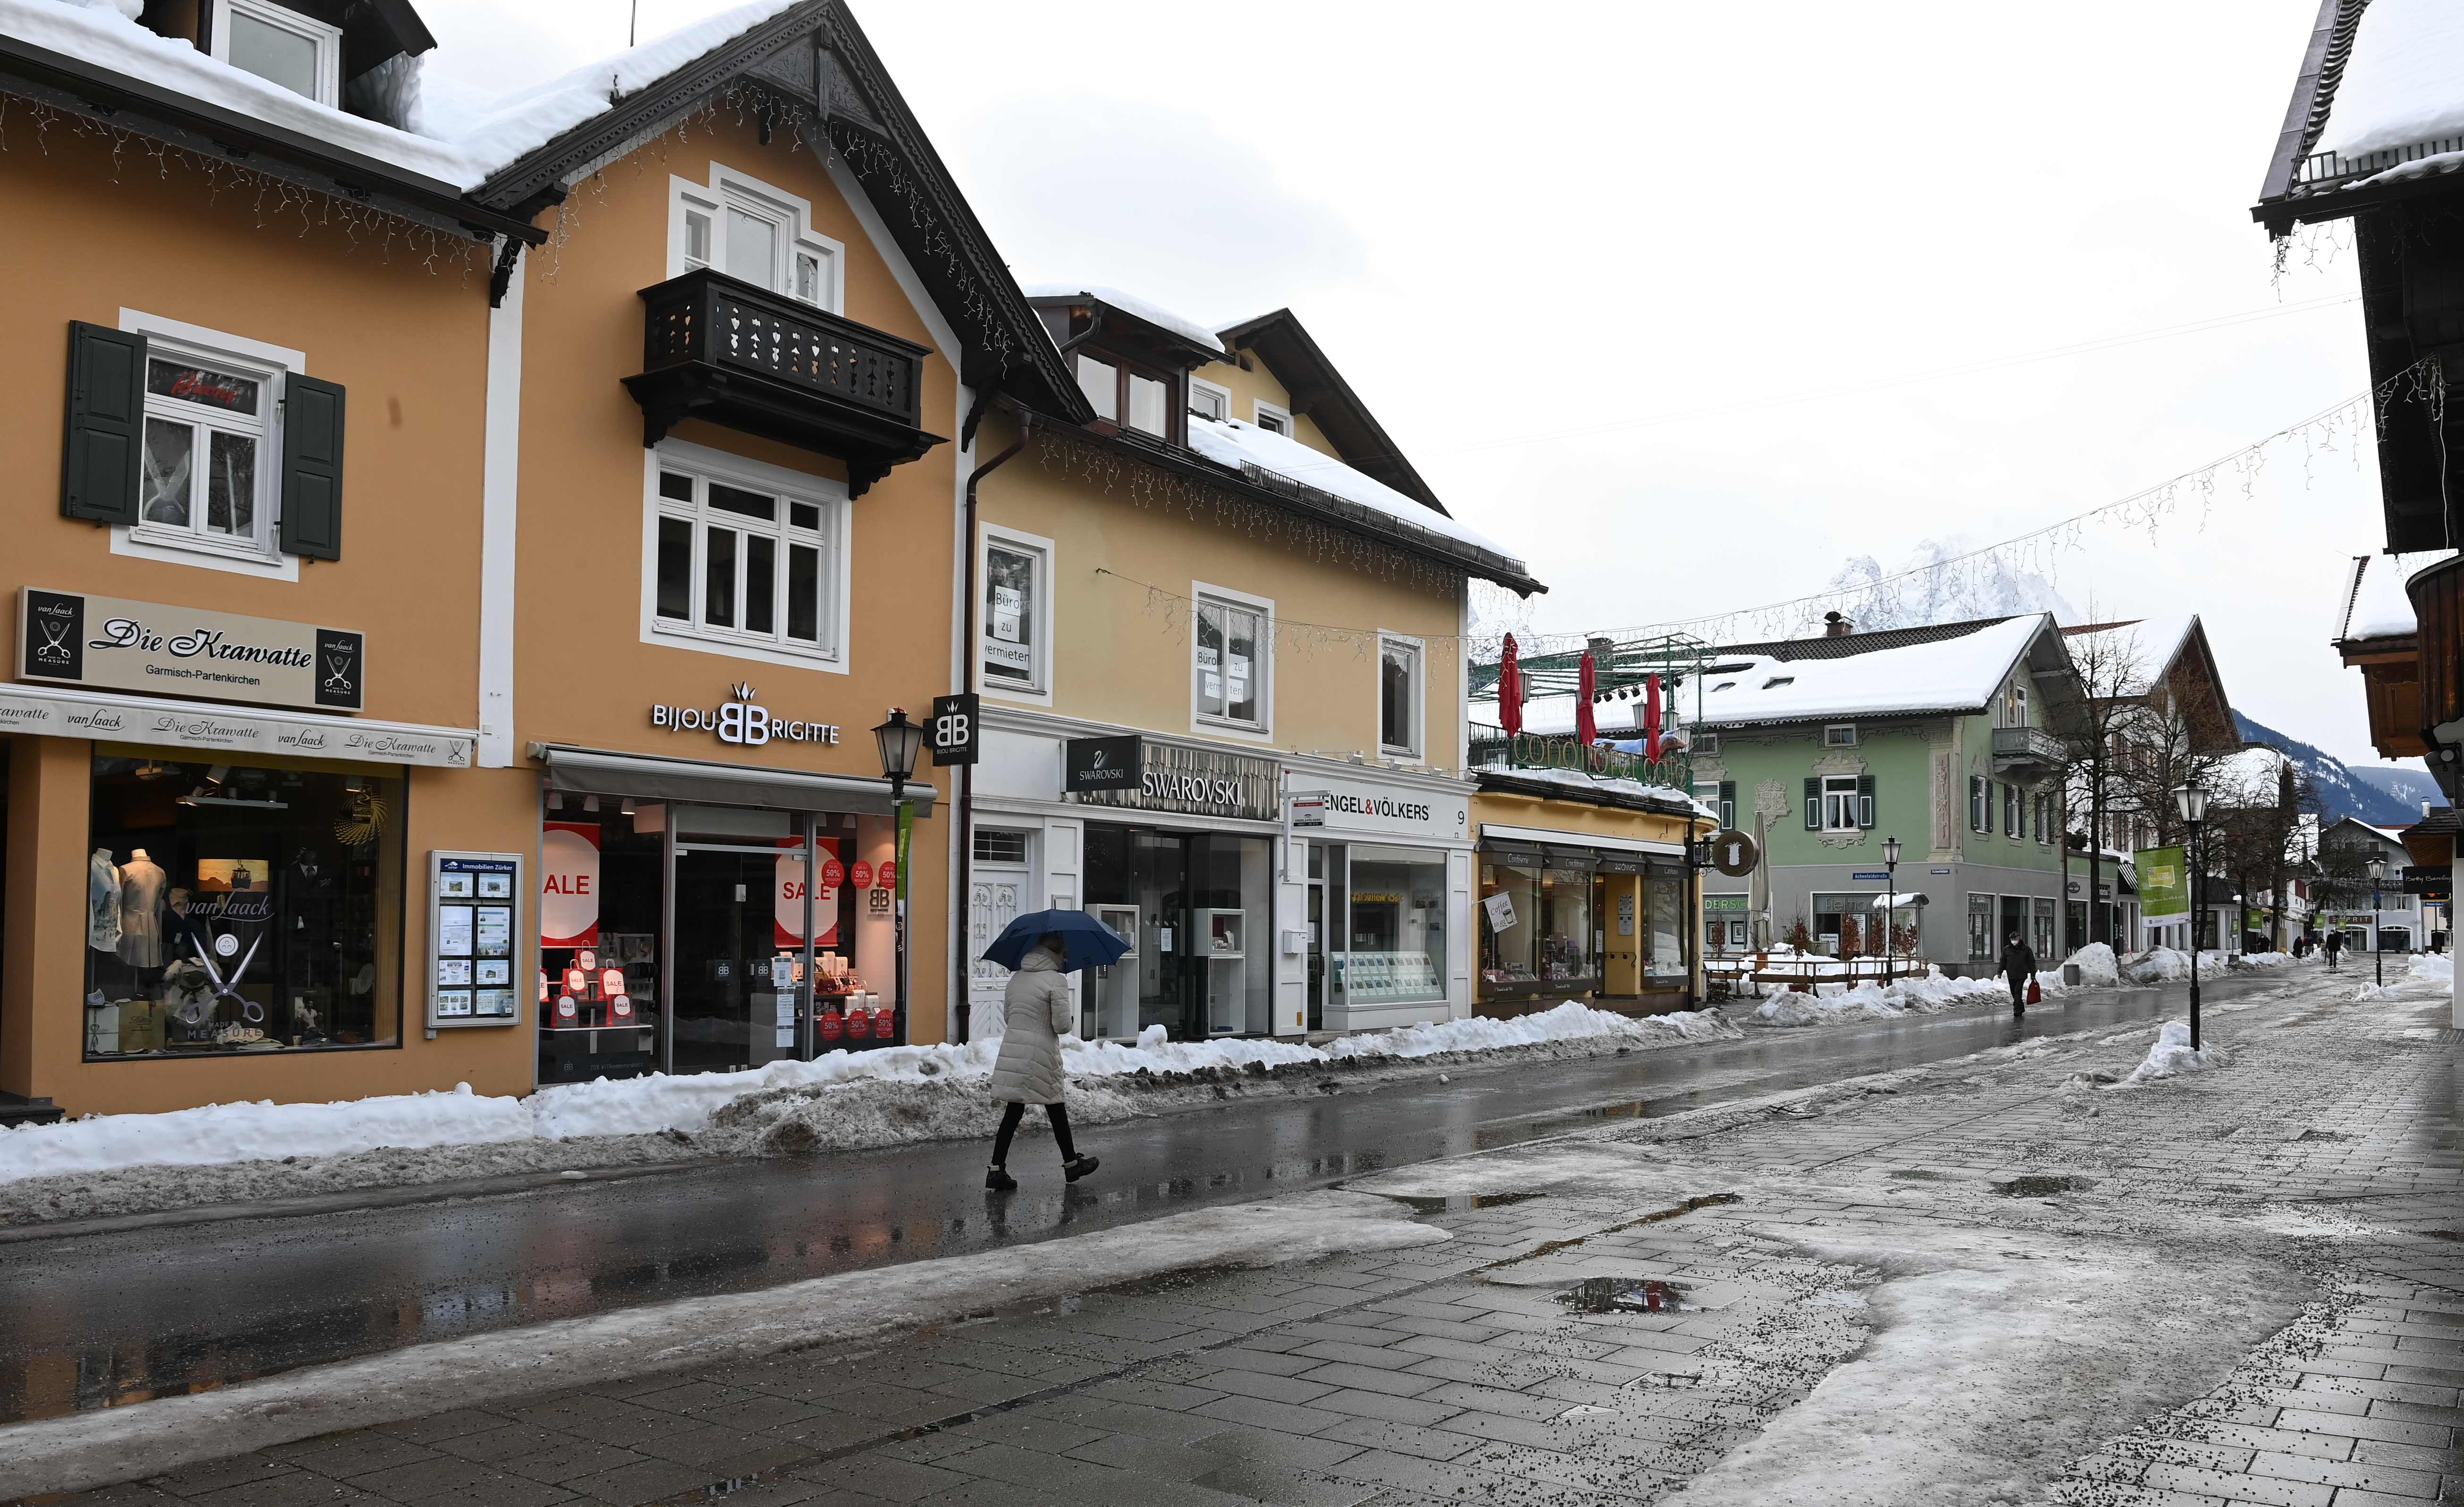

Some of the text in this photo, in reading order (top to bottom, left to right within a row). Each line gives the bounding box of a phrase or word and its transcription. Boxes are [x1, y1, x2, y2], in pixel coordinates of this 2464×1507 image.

[996, 593, 1020, 609] Büro
[48, 603, 75, 618] Laack
[1001, 622, 1011, 632] zu
[89, 618, 312, 668] Die Krawatte
[1198, 652, 1216, 665] Büro
[1234, 663, 1242, 672] zu
[146, 665, 260, 686] Garmisch-Partenkirchen
[1206, 681, 1242, 695] vermten
[0, 708, 49, 720] awatte
[68, 709, 125, 731] van Laack
[654, 704, 716, 732] BIJOU
[151, 717, 259, 738] Die Krawatte
[180, 734, 233, 743] Garmisch-Partenkirchen
[278, 729, 328, 749] van Laack
[344, 734, 436, 753] Die Krawatte
[368, 750, 414, 758] Garmisch-Partenkirchen
[1079, 769, 1123, 781] SWAROVSKI
[1142, 771, 1240, 806] SWAROVSKI
[1458, 810, 1465, 825] 9
[543, 874, 589, 894] ALE
[2405, 875, 2451, 884] Betty Barclay
[783, 882, 831, 900] SAE
[186, 888, 275, 922] van Laack
[1491, 900, 1508, 915] Coffee
[1705, 899, 1750, 910] DERSC
[1826, 897, 1874, 911] fielman
[187, 1028, 261, 1039] MEASURE
